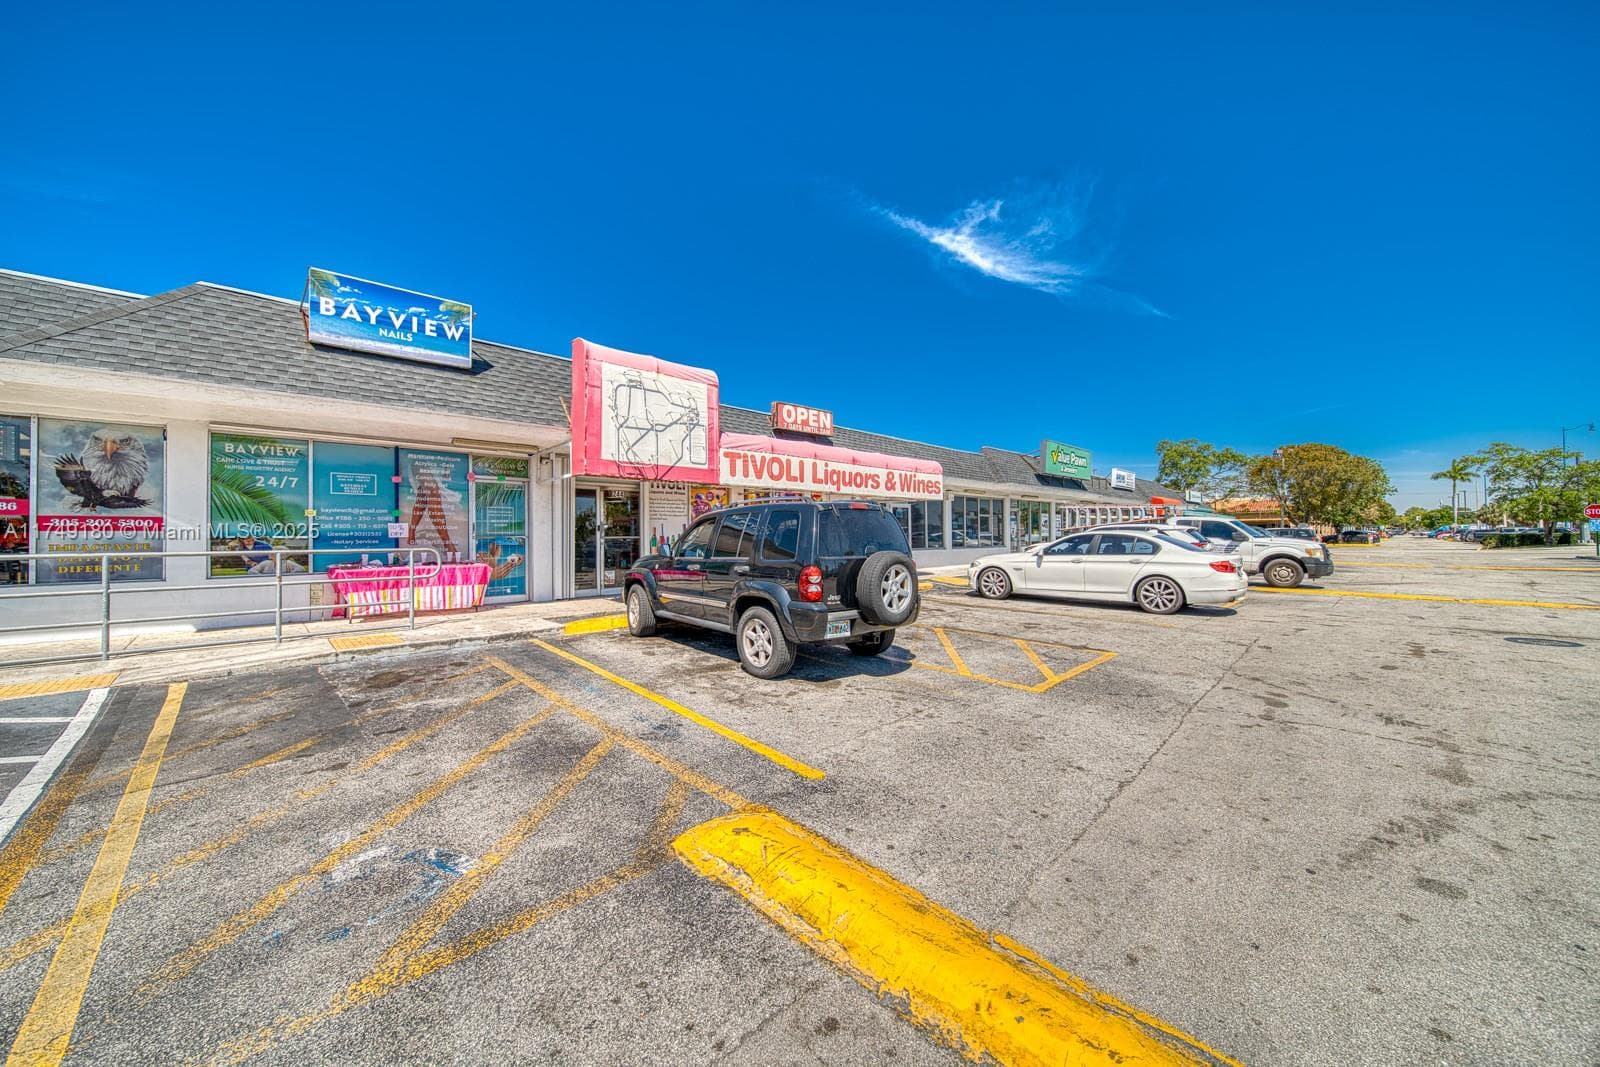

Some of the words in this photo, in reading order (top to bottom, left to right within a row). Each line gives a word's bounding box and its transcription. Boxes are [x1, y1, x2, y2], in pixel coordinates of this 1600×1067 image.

[319, 296, 465, 342] BAYVIEW
[379, 327, 413, 342] NAILS
[782, 404, 831, 430] OPEN
[224, 443, 299, 456] BAYVIEW
[1071, 452, 1088, 469] Pawn
[723, 451, 804, 484] TIVOLI
[811, 461, 881, 492] Liquors
[884, 470, 898, 491] &
[899, 472, 941, 495] Wines
[255, 475, 299, 489] 24/7
